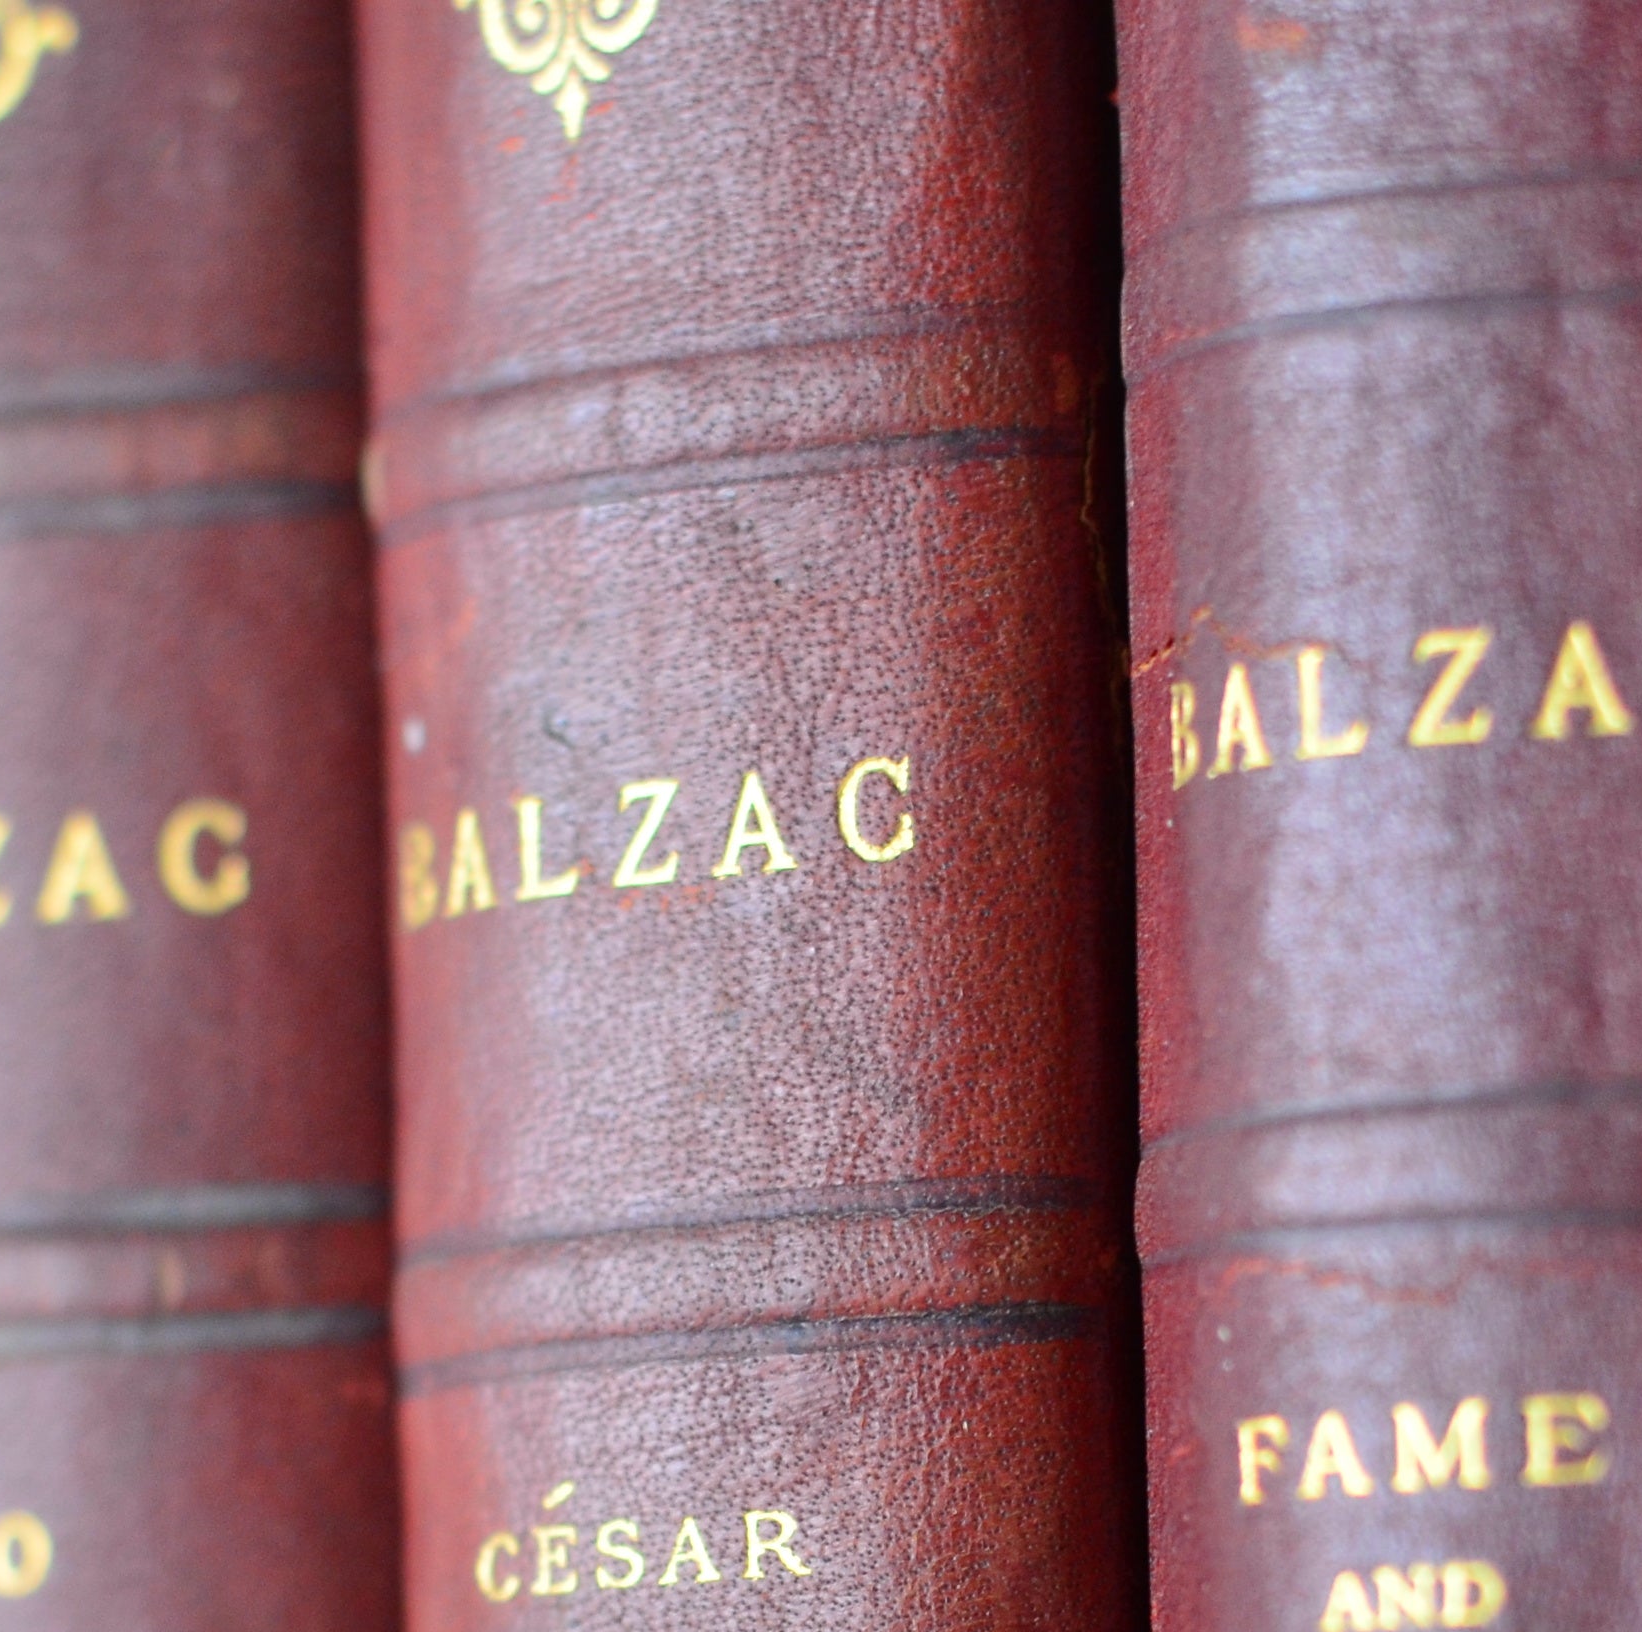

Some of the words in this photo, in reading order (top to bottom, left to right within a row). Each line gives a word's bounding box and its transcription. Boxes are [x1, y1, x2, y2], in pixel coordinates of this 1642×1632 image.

[399, 756, 914, 931] BALZAC
[1237, 1392, 1609, 1505] FAME
[475, 1481, 812, 1603] CÉSAR
